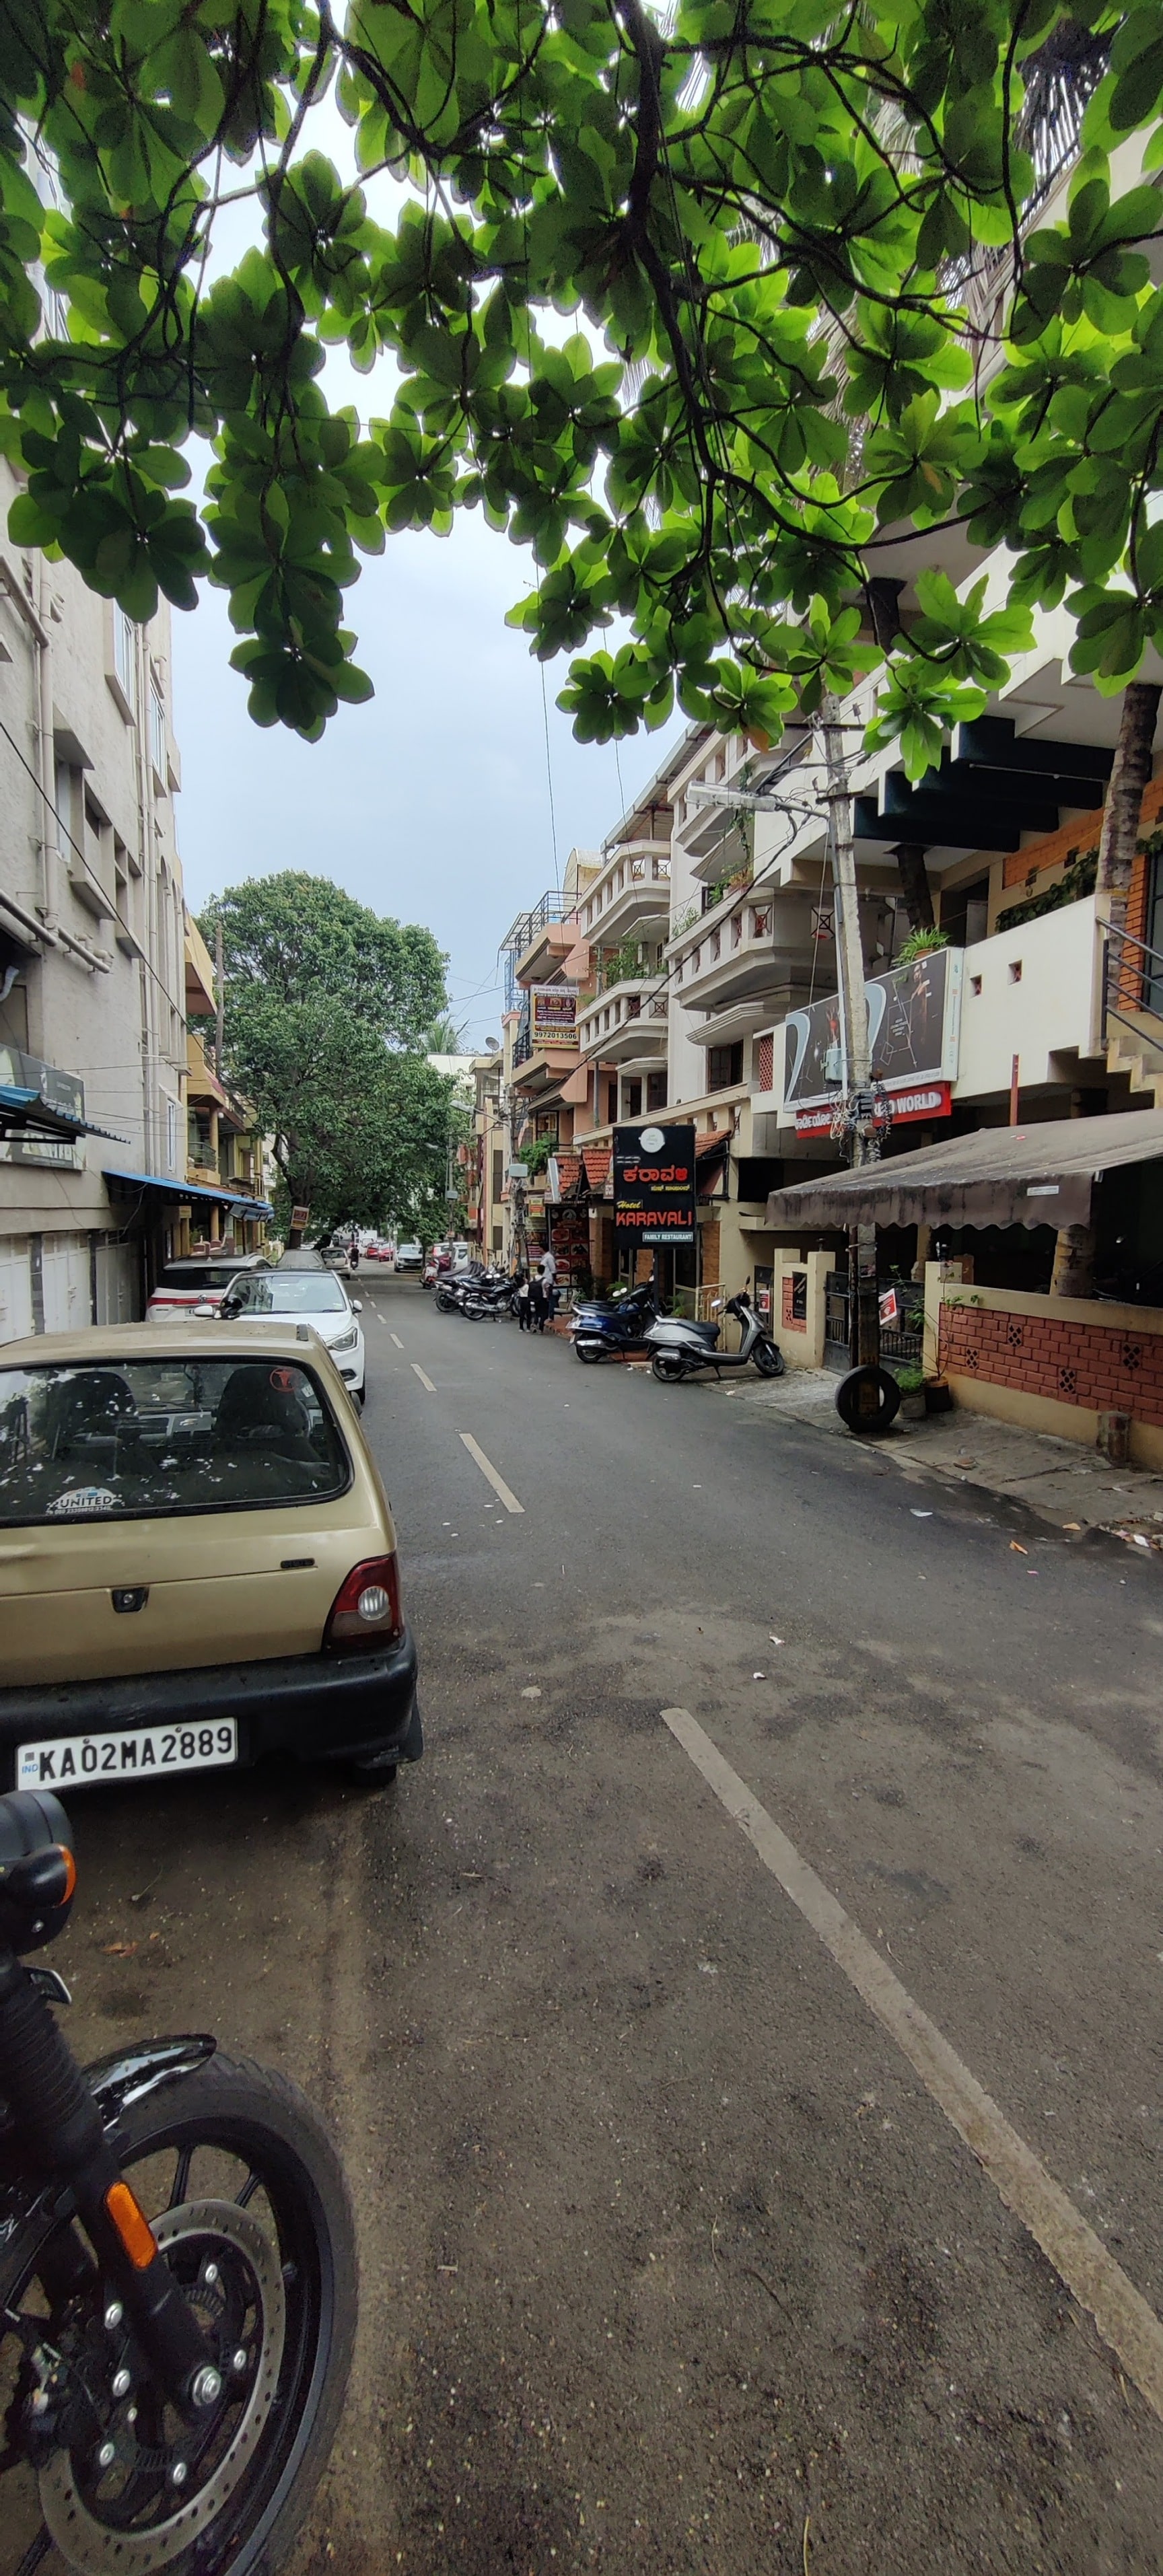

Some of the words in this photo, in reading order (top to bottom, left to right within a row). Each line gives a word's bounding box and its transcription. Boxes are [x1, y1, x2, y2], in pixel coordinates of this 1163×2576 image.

[897, 1092, 941, 1114] WORLD
[616, 1201, 641, 1209] Hotel
[616, 1211, 693, 1227] KARAVALI
[61, 1497, 112, 1508] UNITED
[22, 1764, 38, 1774] IND
[39, 1727, 232, 1782] KA02MA2889
